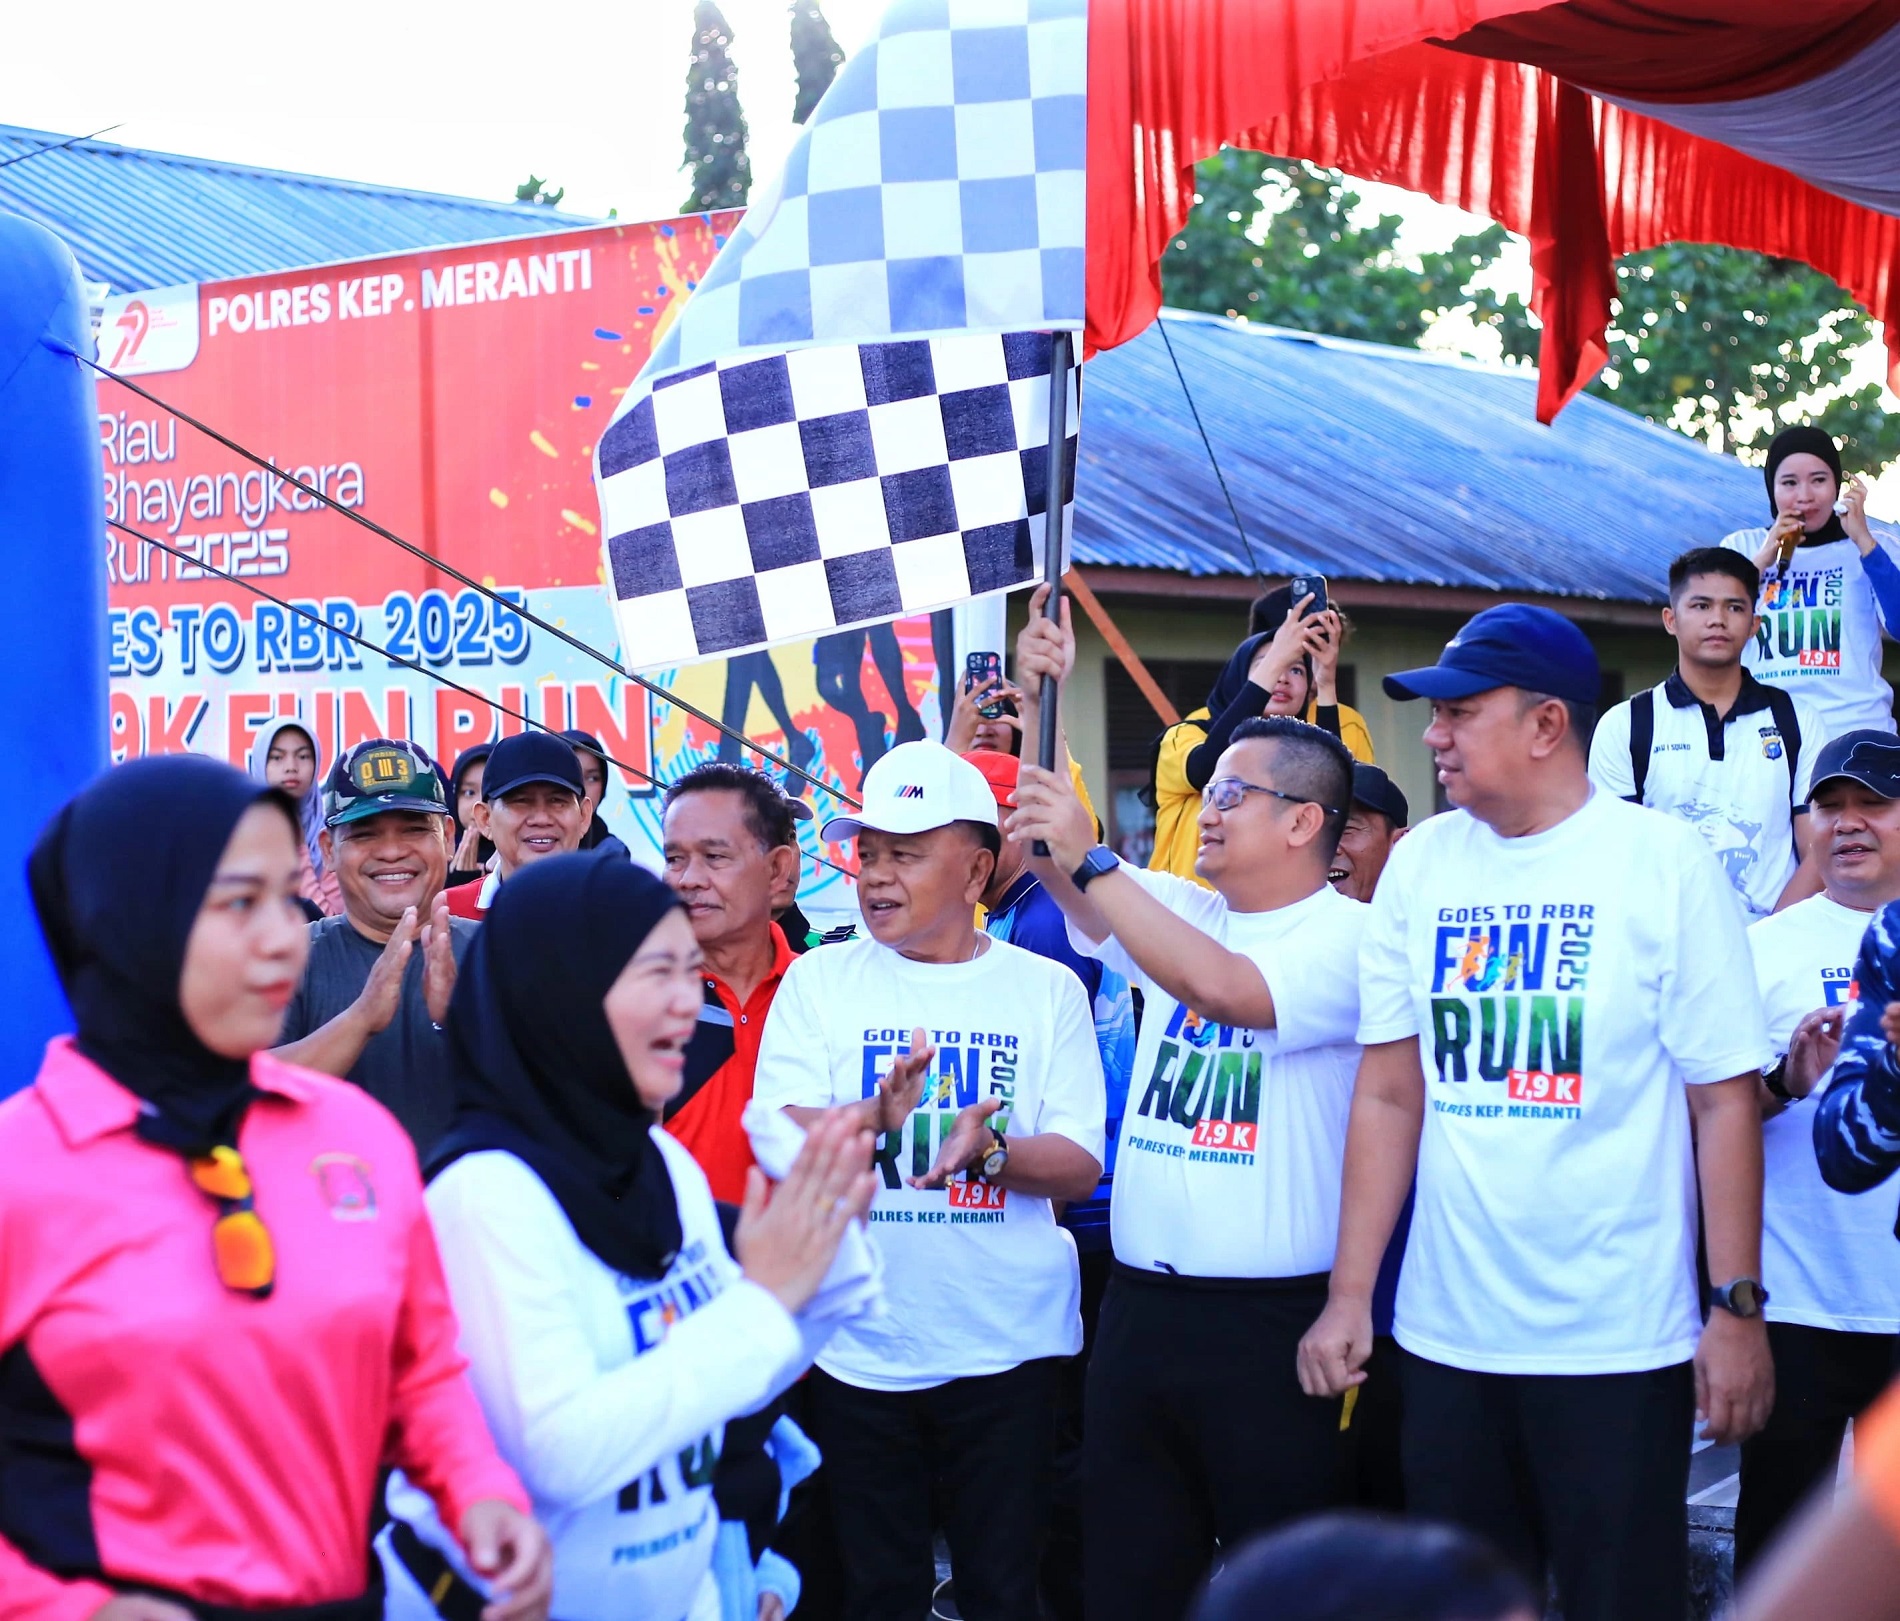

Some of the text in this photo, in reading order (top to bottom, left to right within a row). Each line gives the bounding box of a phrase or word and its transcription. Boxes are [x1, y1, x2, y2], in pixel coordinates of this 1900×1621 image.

[208, 248, 592, 336] POLRES KEP. MERANTI
[174, 528, 290, 581] 2025
[108, 588, 528, 672] ES TO RBR 2025
[1438, 904, 1595, 923] GOES TO RBR
[1431, 923, 1550, 993] FUN
[1556, 922, 1594, 991] 2025
[1821, 967, 1851, 978] GO
[863, 1029, 1019, 1050] GOE TO RBR
[1431, 996, 1584, 1083] RUN
[1513, 1073, 1577, 1101] 7,9 K
[1508, 1105, 1582, 1120] MERANTI
[1198, 1122, 1252, 1148] 7,9 K
[1188, 1150, 1255, 1166] MERANTI
[955, 1183, 1001, 1207] 7,9 K
[868, 1211, 1005, 1224] OLRES KEP. MERANTI
